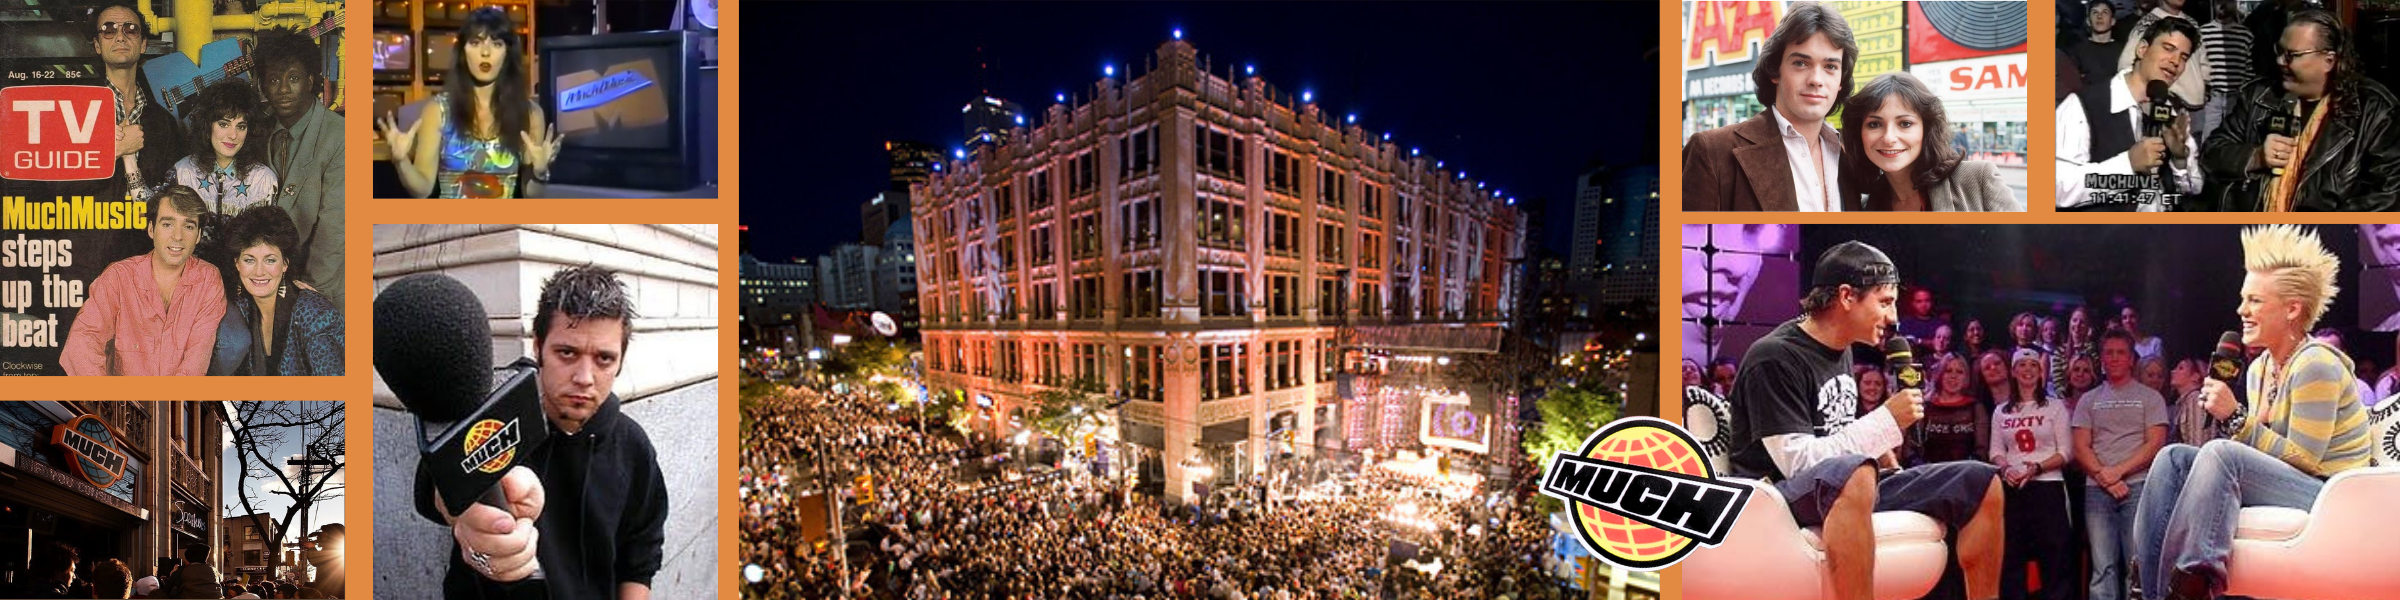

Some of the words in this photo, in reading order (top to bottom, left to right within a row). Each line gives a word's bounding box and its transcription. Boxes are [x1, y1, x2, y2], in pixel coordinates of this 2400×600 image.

[8, 71, 28, 80] Aug.
[32, 71, 55, 79] 16-22
[65, 71, 82, 79] 85¢
[1703, 74, 1744, 95] RECORDS
[12, 100, 102, 144] TV
[14, 150, 101, 169] GUIDE
[2, 196, 148, 230] MuchMusic
[2, 233, 73, 273] steps
[2, 279, 32, 314] up
[42, 274, 84, 308] the
[2, 313, 59, 348] beat
[2, 361, 43, 370] Clockwise
[2003, 415, 2045, 429] SIXTY
[63, 428, 124, 476] MUCH
[462, 420, 519, 472] MUCH
[2014, 429, 2036, 453] 8
